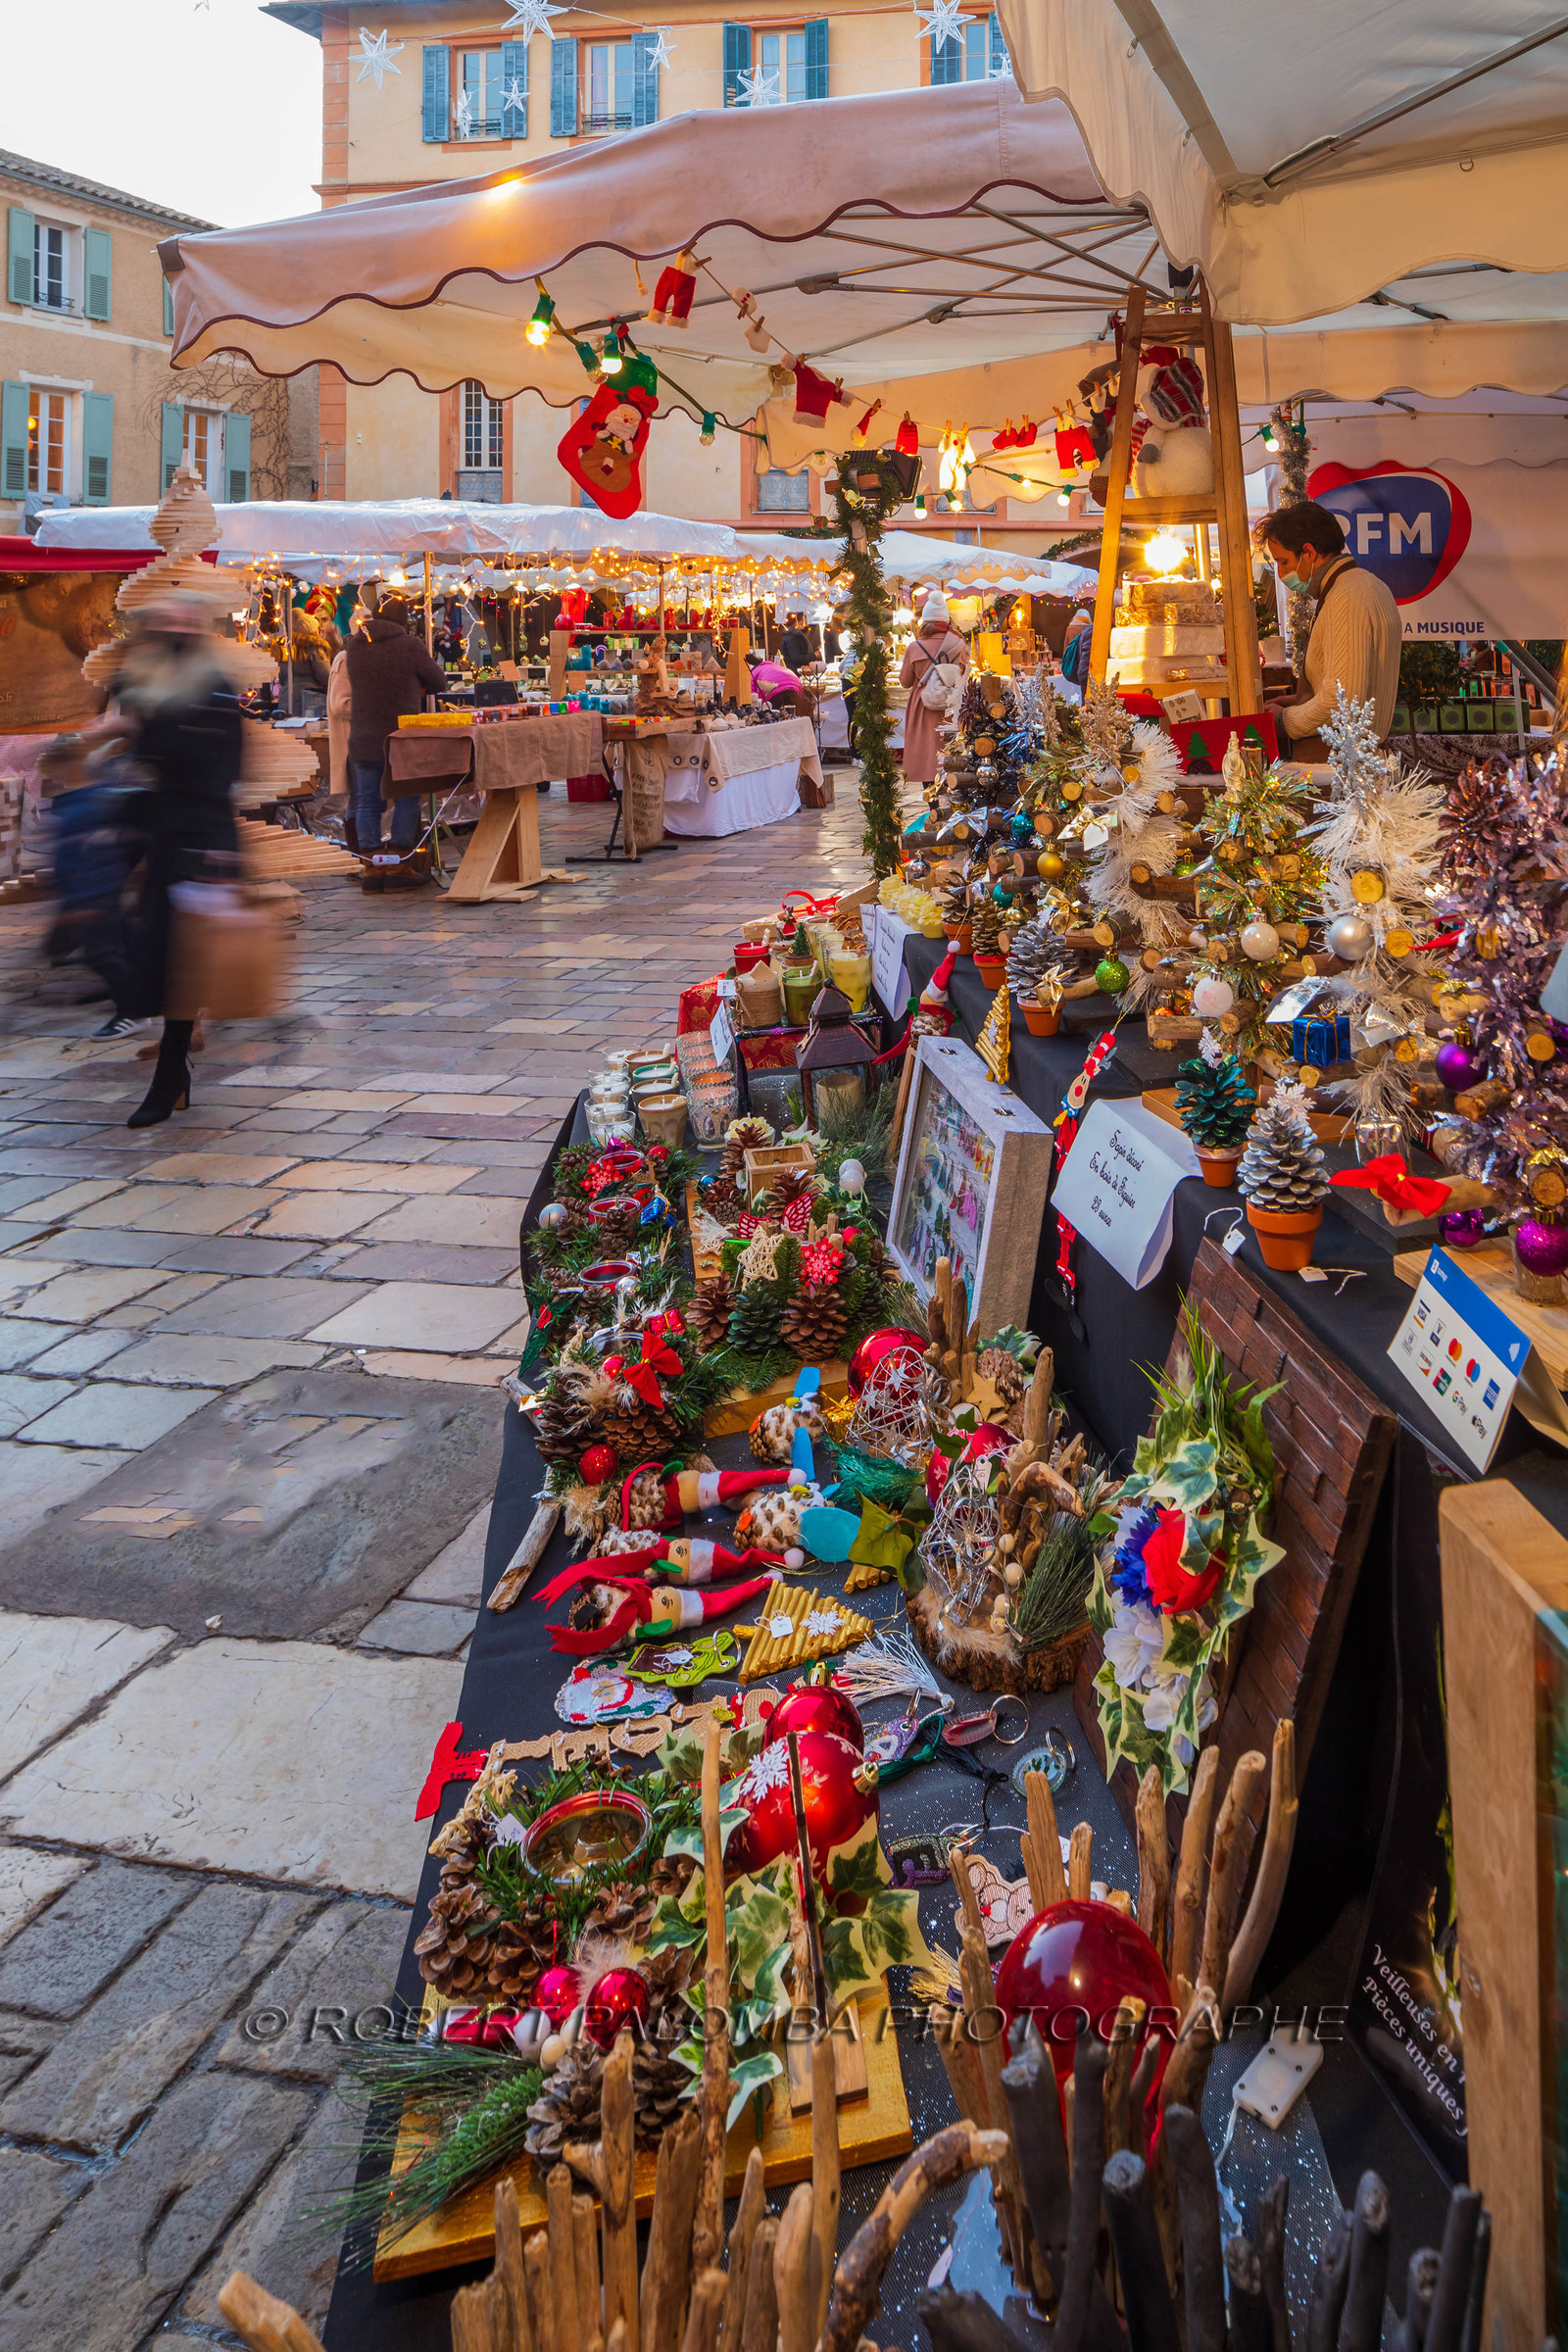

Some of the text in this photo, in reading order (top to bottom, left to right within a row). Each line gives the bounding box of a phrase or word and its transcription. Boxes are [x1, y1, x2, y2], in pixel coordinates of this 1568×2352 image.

[1417, 621, 1486, 636] MUSIQUE
[1109, 1129, 1145, 1172] Sapin décoré
[1089, 1152, 1136, 1209] En bois de Figuier
[1091, 1196, 1111, 1227] 23 euros
[1456, 1396, 1468, 1416] Pay
[1475, 1417, 1488, 1440] Pay
[1374, 1943, 1457, 2074] Veilleuses en
[1362, 1976, 1465, 2121] Pièces uniques
